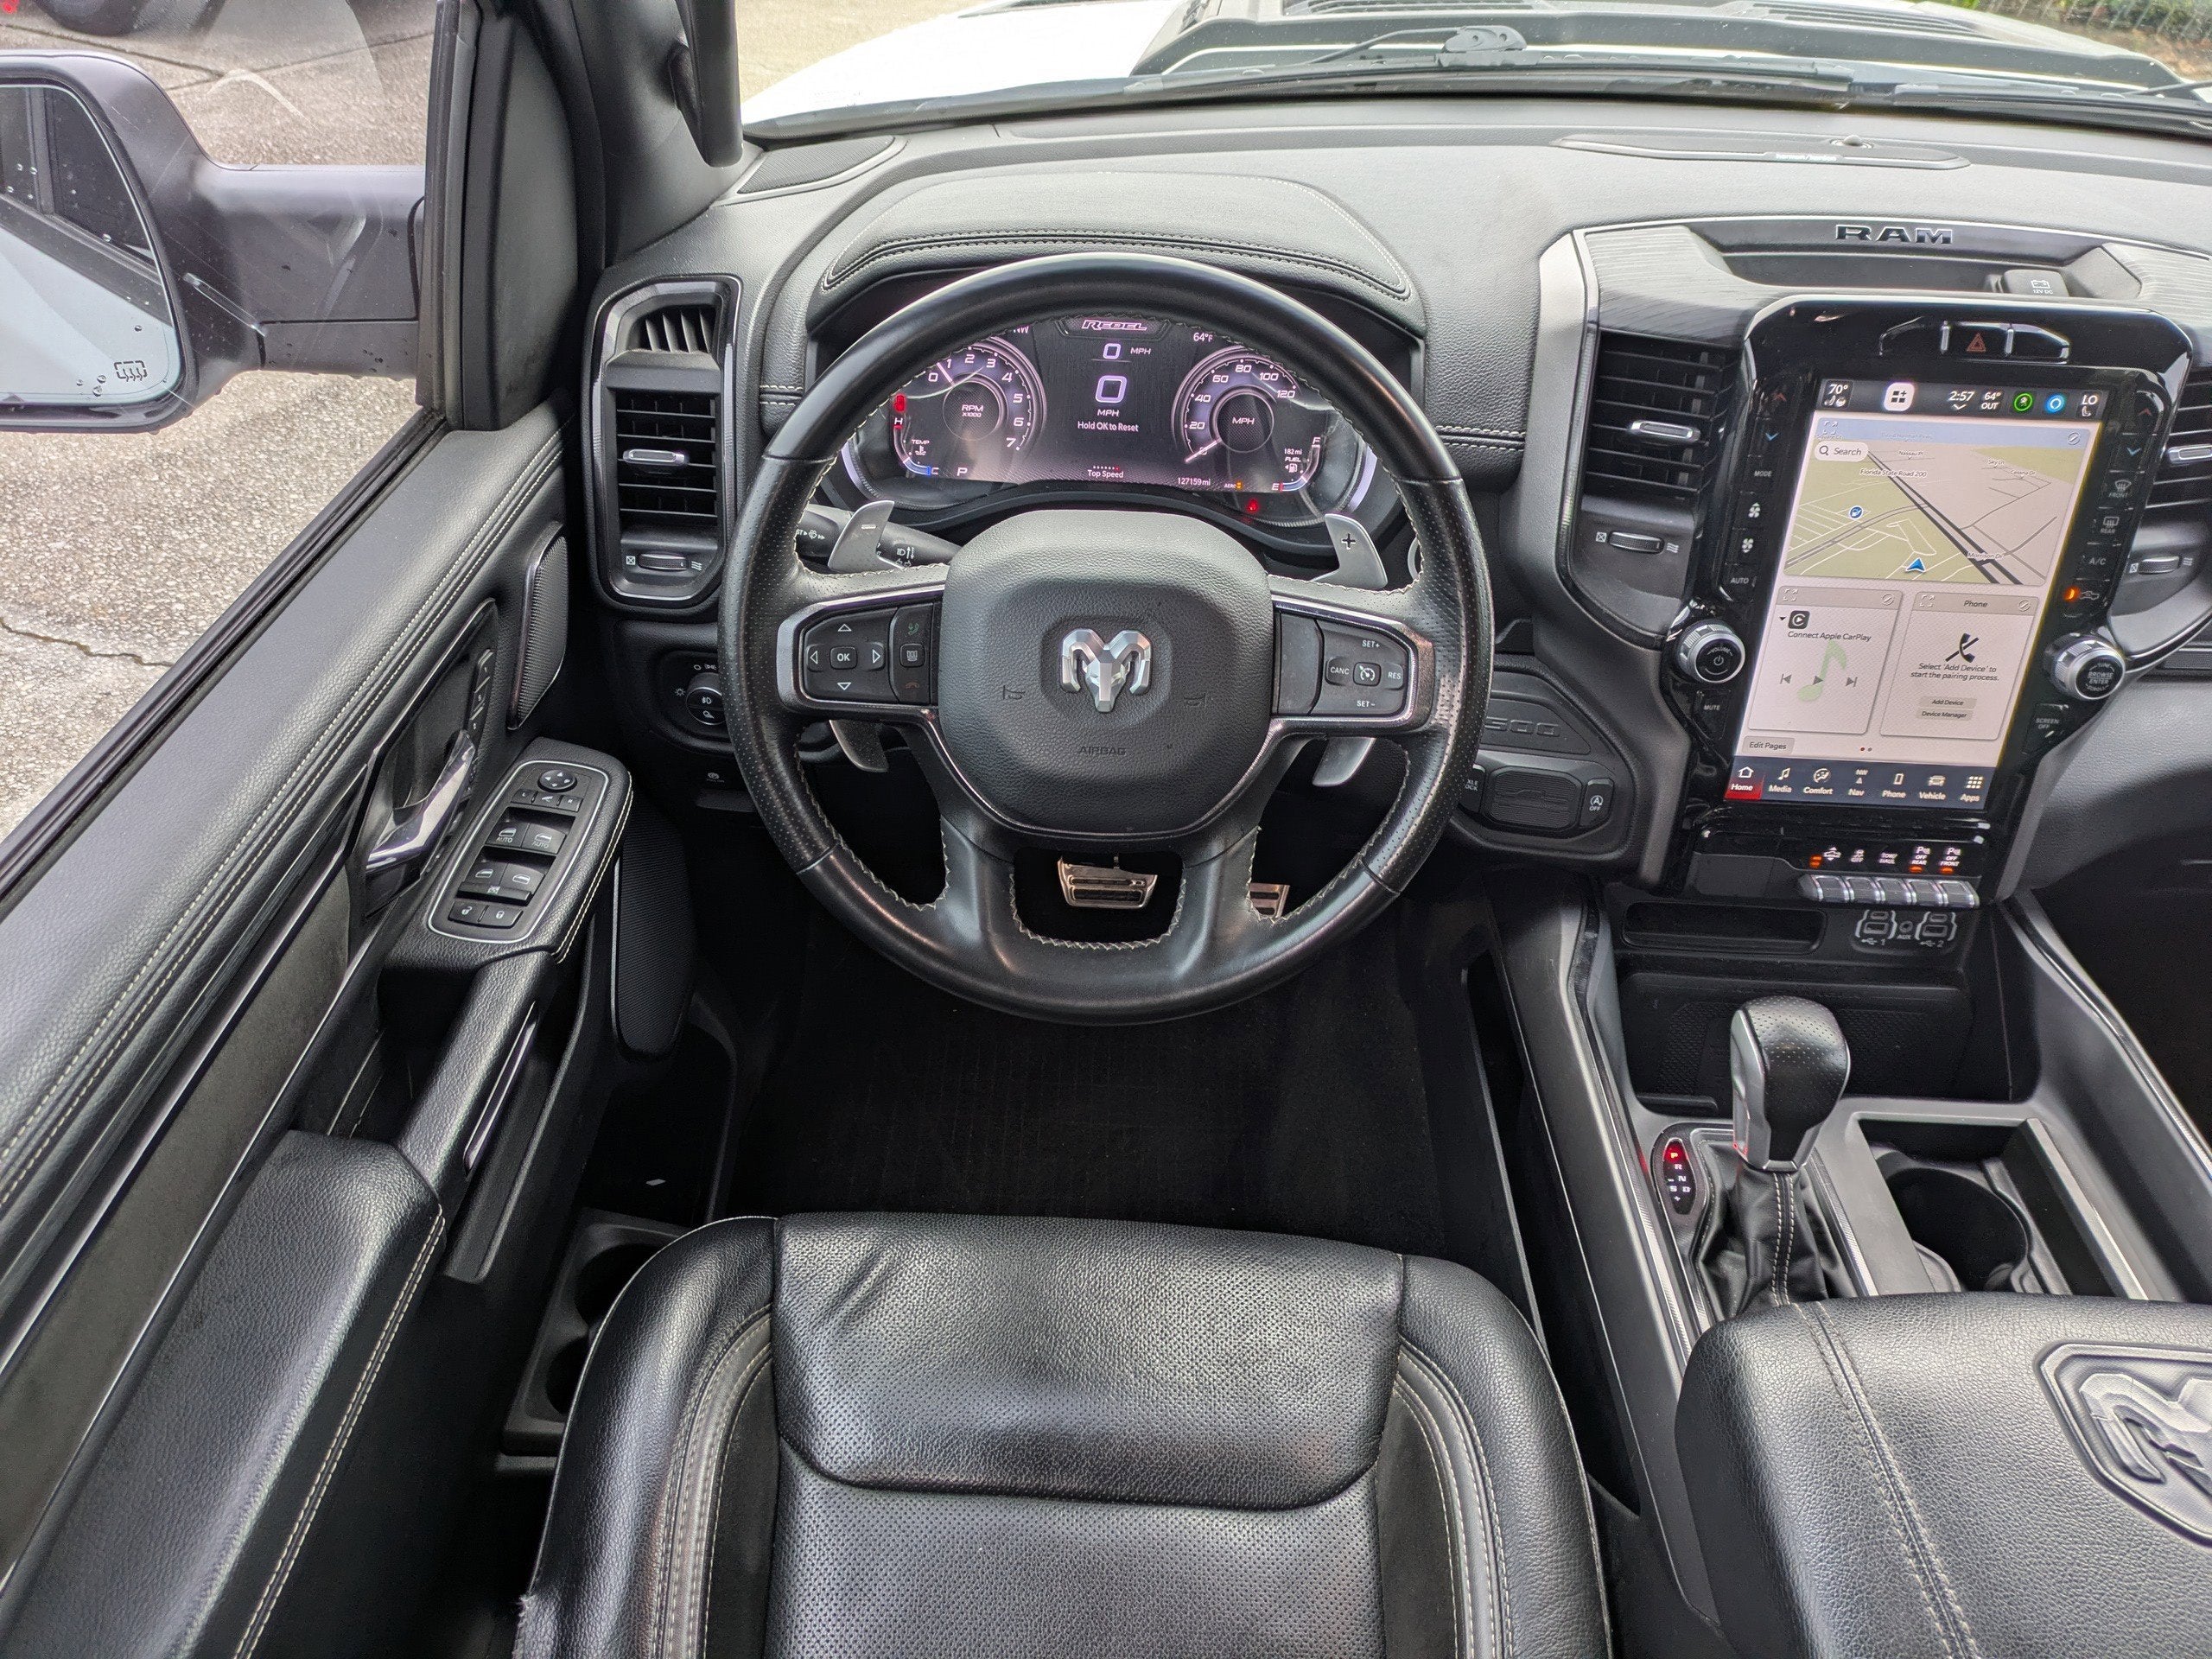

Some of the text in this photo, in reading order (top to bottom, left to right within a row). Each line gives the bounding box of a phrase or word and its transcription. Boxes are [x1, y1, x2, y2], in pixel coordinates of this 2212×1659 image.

[1835, 224, 1953, 245] RAM
[1082, 320, 1147, 331] REBEL
[1193, 332, 1213, 343] 64°F
[1103, 343, 1122, 359] 0
[964, 354, 975, 363] 2
[946, 359, 952, 369] 1
[986, 359, 996, 368] 3
[1236, 365, 1251, 373] 80
[928, 373, 938, 382] 0
[1001, 372, 1012, 382] 4
[1212, 375, 1229, 383] 60
[1259, 372, 1279, 381] 100
[1095, 375, 1128, 404] 0
[1828, 384, 1848, 394] 70°
[1013, 394, 1023, 403] 5
[1195, 394, 1211, 403] 40
[1277, 390, 1296, 398] 120
[1948, 391, 1974, 402] 2:57
[1984, 391, 2001, 401] 64°
[2082, 394, 2099, 405] LO
[1980, 402, 1999, 410] OUT
[1096, 409, 1120, 417] MPH
[1014, 417, 1024, 426] 6
[1232, 416, 1255, 425] MPH
[1077, 421, 1139, 432] Hold OK to Reset
[1189, 421, 1205, 430] 20
[1006, 438, 1017, 448] 7
[1834, 447, 1862, 456] Search
[957, 467, 968, 476] P
[1087, 469, 1124, 479] Top Speed
[2089, 557, 2107, 566] A/C
[1963, 600, 1988, 608] Phone
[1788, 631, 1872, 642] Connect Apple CarPlay
[837, 653, 850, 662] OK
[1330, 666, 1349, 675] CANC
[1919, 663, 1941, 671] Select
[1388, 671, 1401, 680] RES
[1942, 673, 1969, 682] pairing
[1079, 746, 1127, 756] AIRBAG
[1765, 743, 1787, 751] Pages
[1731, 783, 1753, 791] Home
[1768, 785, 1792, 794] Media
[1803, 787, 1833, 795] Comfort
[1848, 788, 1865, 797] Nav
[1882, 790, 1907, 799] Phone
[1919, 791, 1946, 801] Vehicle
[1960, 794, 1980, 803] Apps
[532, 840, 549, 849] AUTO
